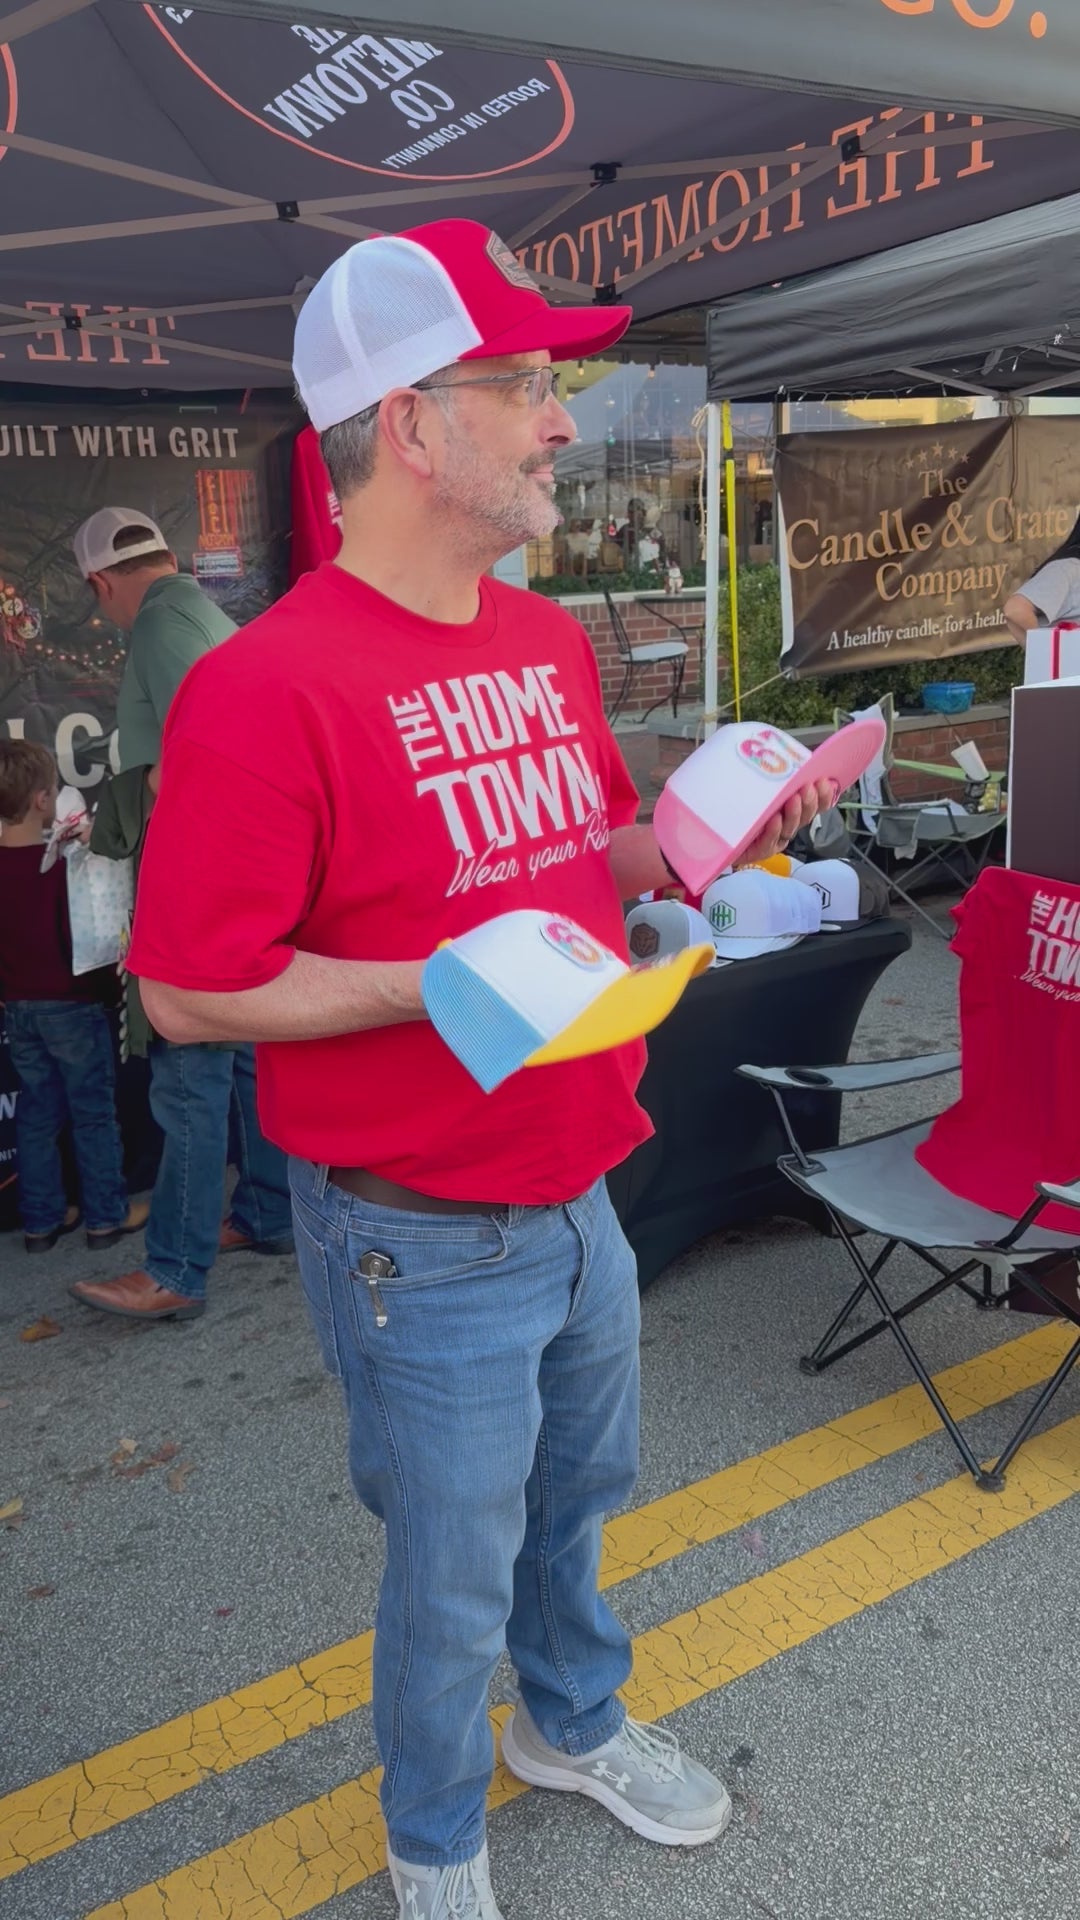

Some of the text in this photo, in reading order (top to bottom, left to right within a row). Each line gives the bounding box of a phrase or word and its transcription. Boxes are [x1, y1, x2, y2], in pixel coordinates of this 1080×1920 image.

[72, 426, 157, 457] WITH
[169, 427, 238, 458] GRIT
[919, 470, 968, 499] The
[787, 497, 1069, 569] Candle & Crate
[876, 563, 1008, 605] Company
[827, 632, 839, 651] A
[843, 625, 893, 648] healthy
[896, 618, 943, 640] candle,
[945, 614, 965, 632] for
[975, 609, 1008, 629] healt
[387, 690, 444, 771] THE
[424, 664, 579, 760] HOME
[445, 839, 519, 898] Wear
[529, 841, 577, 880] your
[1030, 890, 1056, 926] THE
[1020, 967, 1056, 993] Wear
